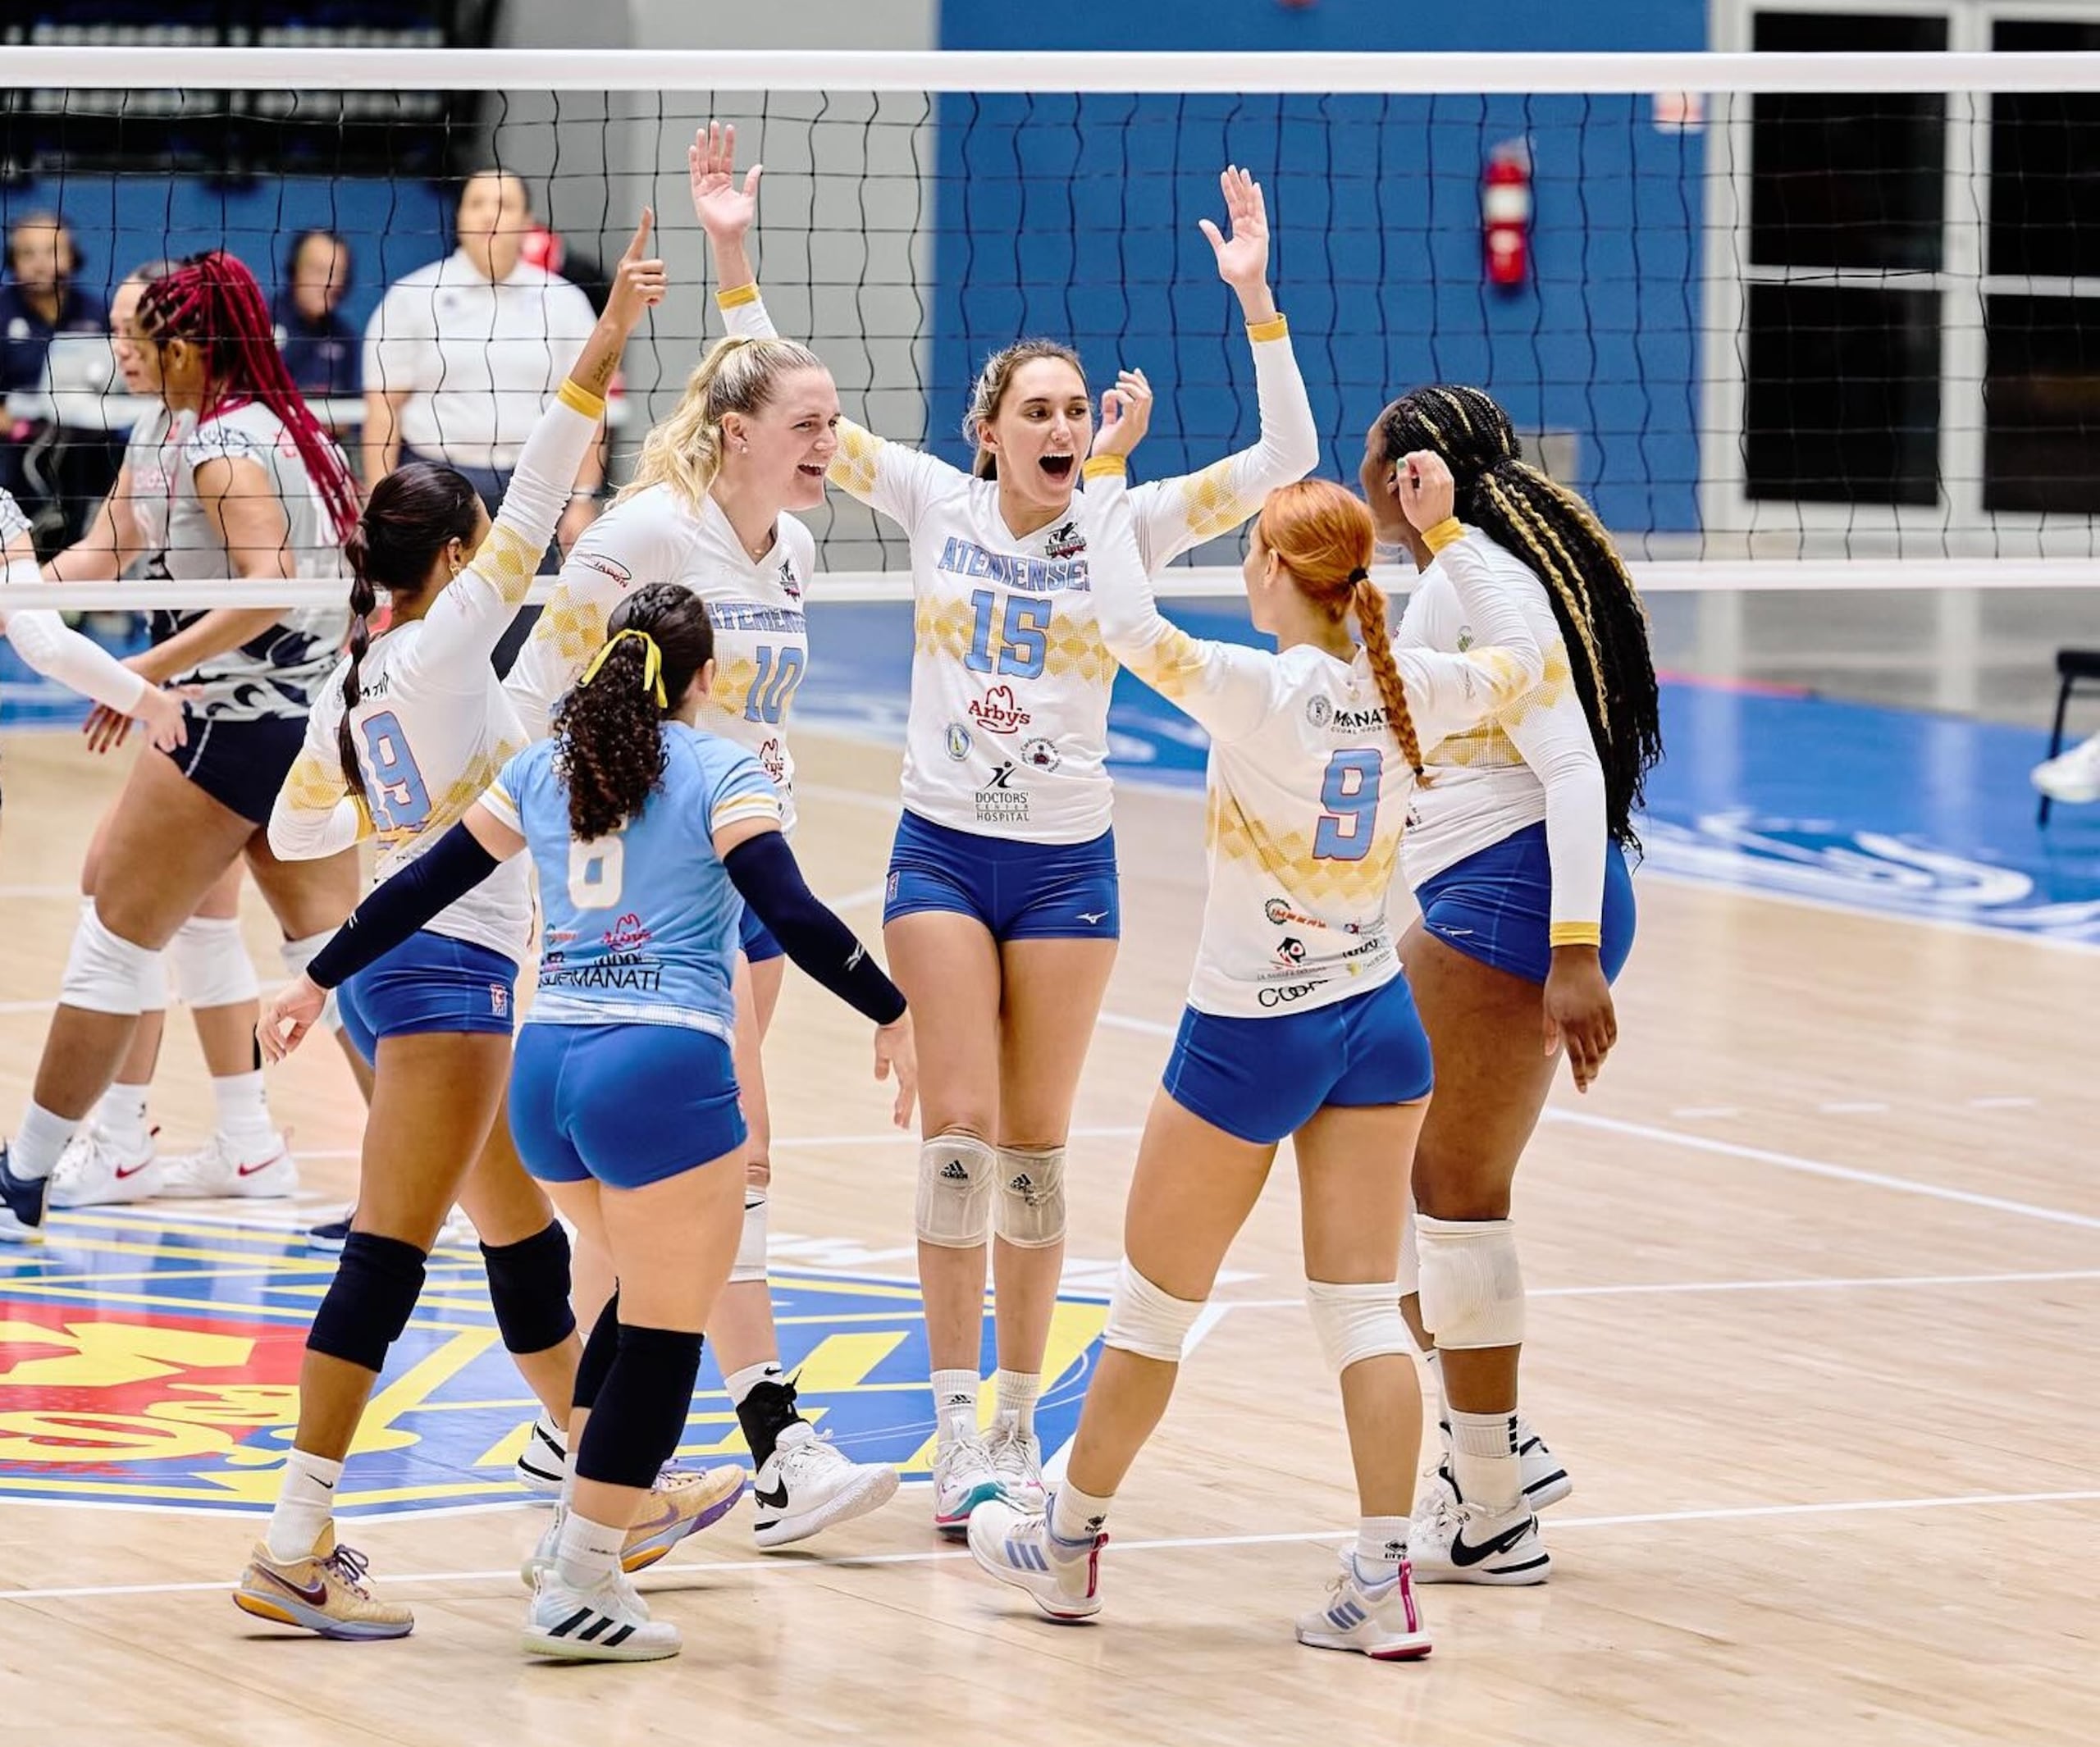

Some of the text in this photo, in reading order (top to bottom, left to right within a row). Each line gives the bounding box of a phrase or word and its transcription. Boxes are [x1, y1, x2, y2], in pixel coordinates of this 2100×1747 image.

[964, 589, 1052, 680] 15
[743, 645, 804, 724] 10
[968, 700, 1031, 727] Arby's
[975, 791, 1029, 803] DOCTORS'
[976, 812, 1029, 822] HOSPITAL
[1312, 748, 1384, 861] 9
